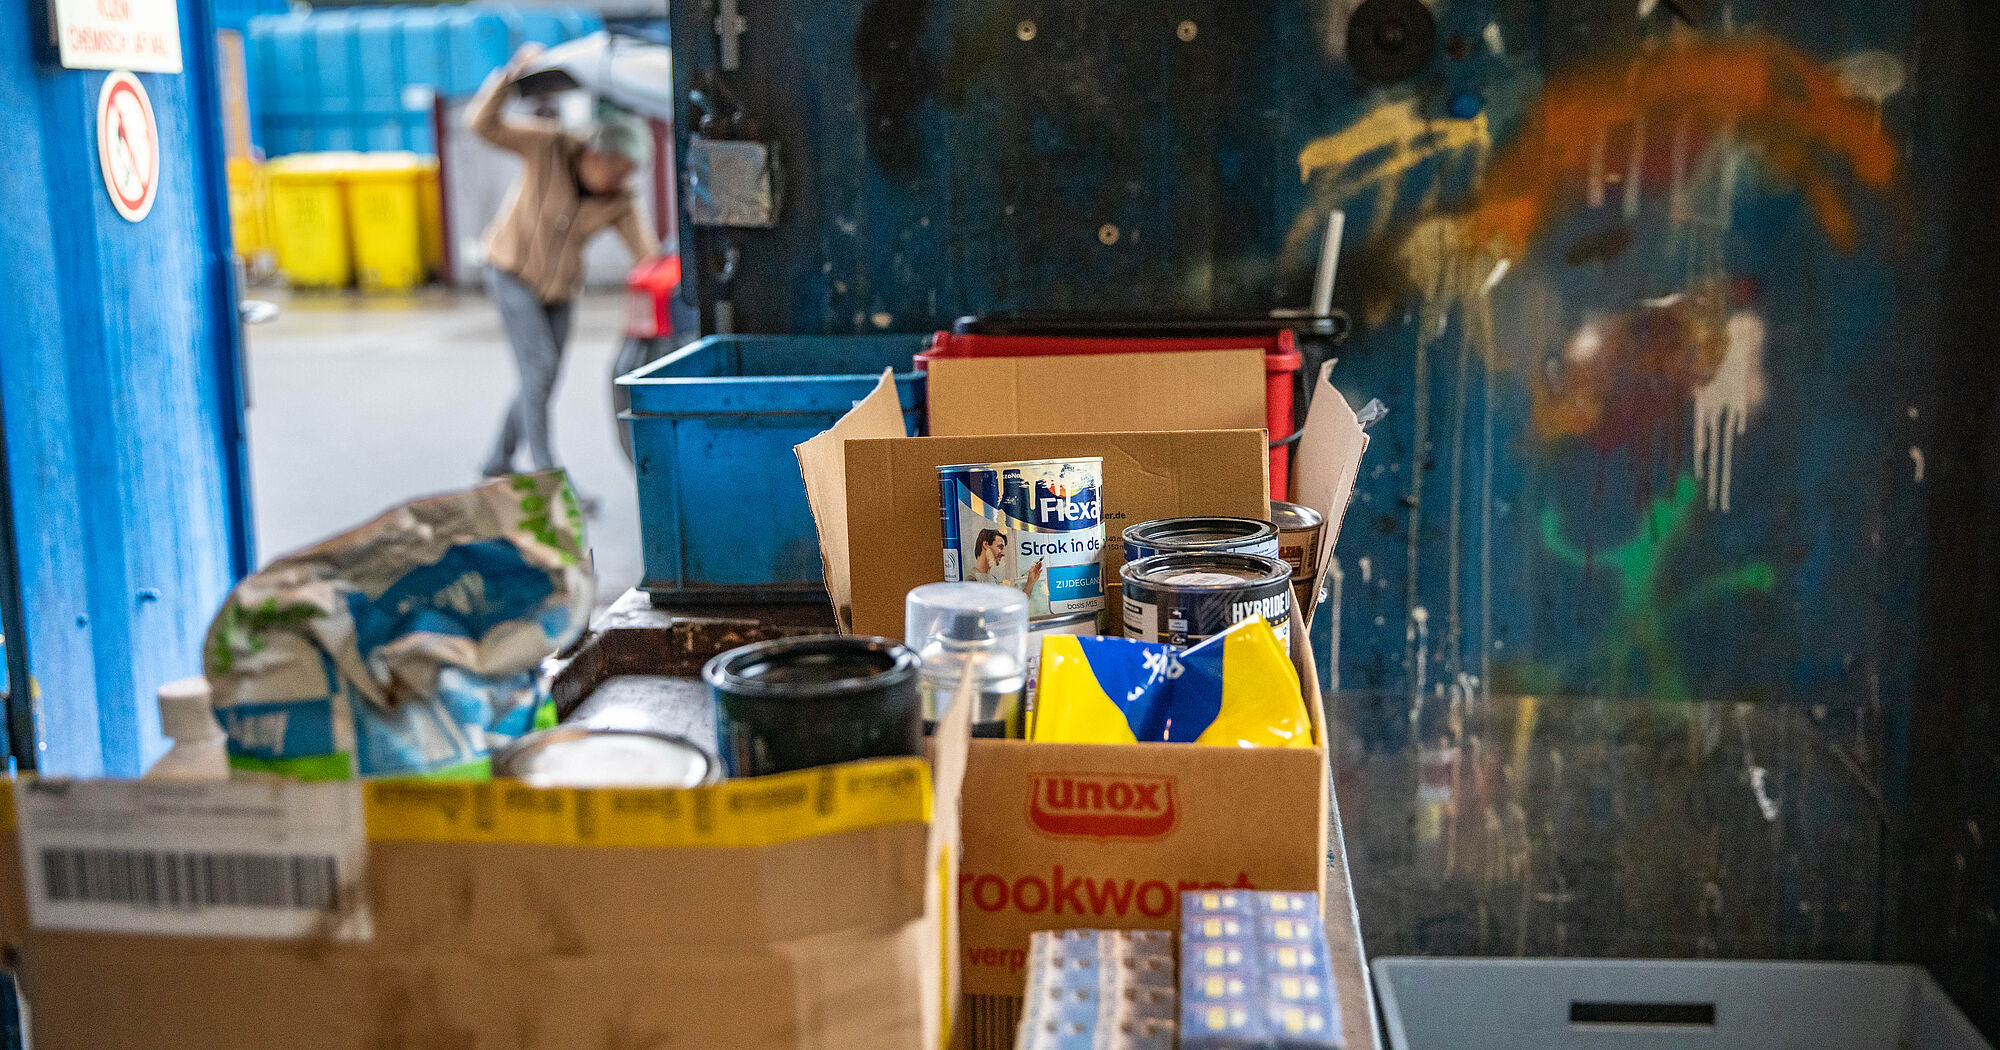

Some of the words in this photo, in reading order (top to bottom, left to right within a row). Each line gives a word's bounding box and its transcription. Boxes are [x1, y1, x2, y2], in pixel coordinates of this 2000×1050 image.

[68, 25, 127, 55] CHEMISCH
[133, 31, 169, 56] AFVAL
[1040, 497, 1101, 523] Flexa
[1021, 540, 1066, 557] Strak
[1070, 538, 1084, 554] in
[1087, 537, 1100, 551] de
[1056, 577, 1101, 589] ZIJDEGLAN
[1067, 602, 1085, 611] basis
[1085, 600, 1098, 609] M15
[1046, 778, 1160, 811] unox
[960, 866, 1256, 918] rookwo
